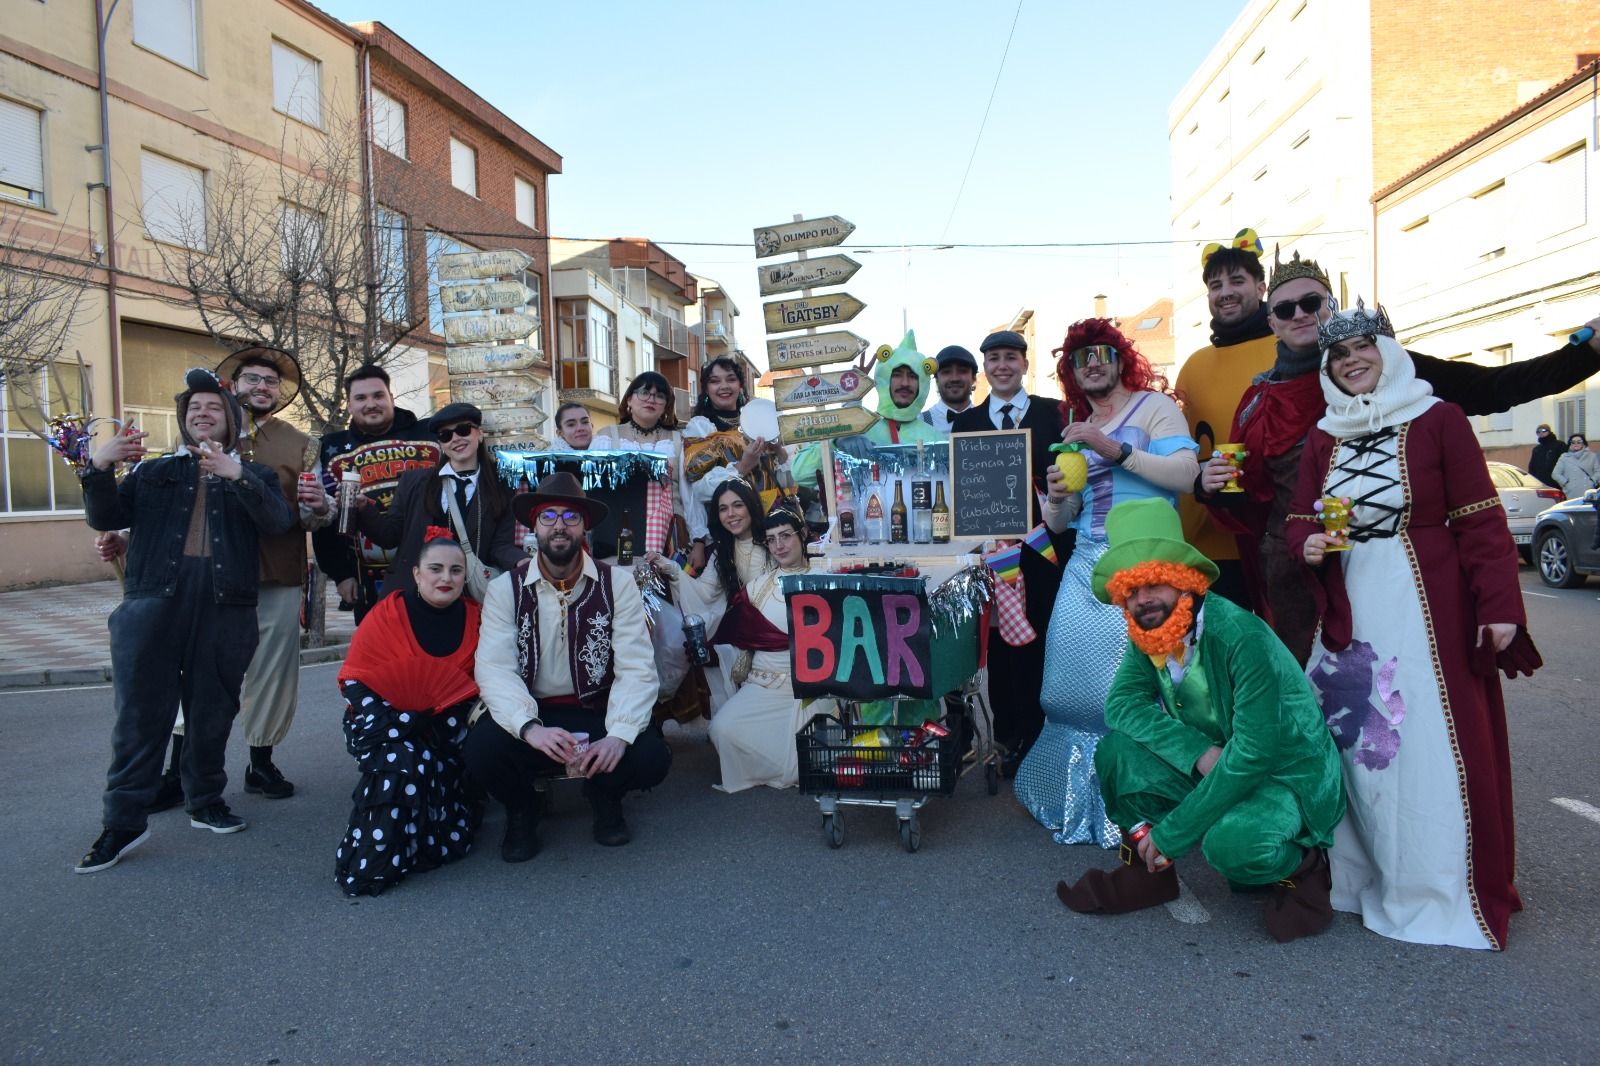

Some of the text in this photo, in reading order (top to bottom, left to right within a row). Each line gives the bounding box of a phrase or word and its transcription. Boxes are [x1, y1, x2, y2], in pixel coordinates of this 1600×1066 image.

[783, 226, 838, 242] OLIMPO PUB
[786, 304, 839, 324] GATSBY
[789, 341, 814, 350] HOTEL
[789, 350, 815, 359] REYES
[824, 343, 846, 353] LEÓN
[487, 441, 536, 453] IGUANA
[354, 445, 416, 466] CASINO
[790, 594, 925, 688] BAR
